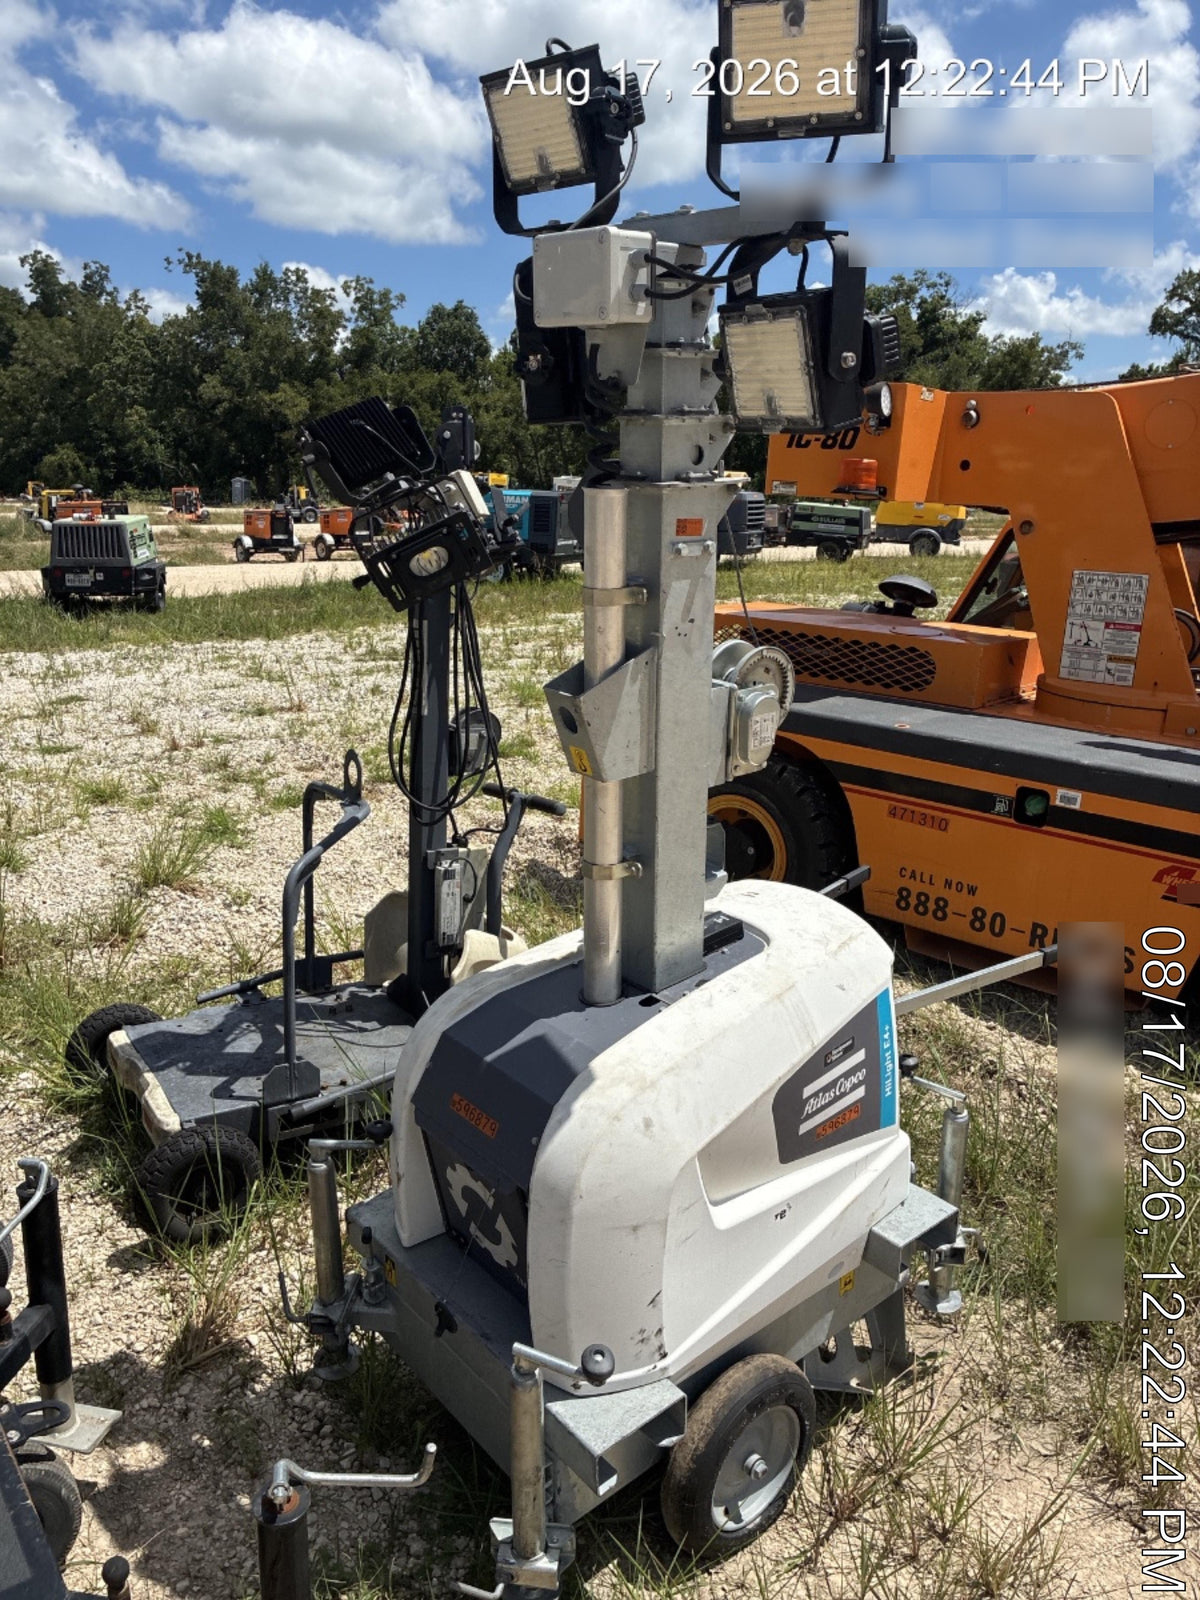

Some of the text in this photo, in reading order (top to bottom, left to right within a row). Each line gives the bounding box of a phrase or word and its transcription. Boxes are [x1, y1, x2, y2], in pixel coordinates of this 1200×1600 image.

[888, 805, 949, 833] 471310
[899, 866, 978, 897] CALL NOW
[884, 1050, 894, 1098] HiLight
[800, 1068, 867, 1120] Atlas Copco
